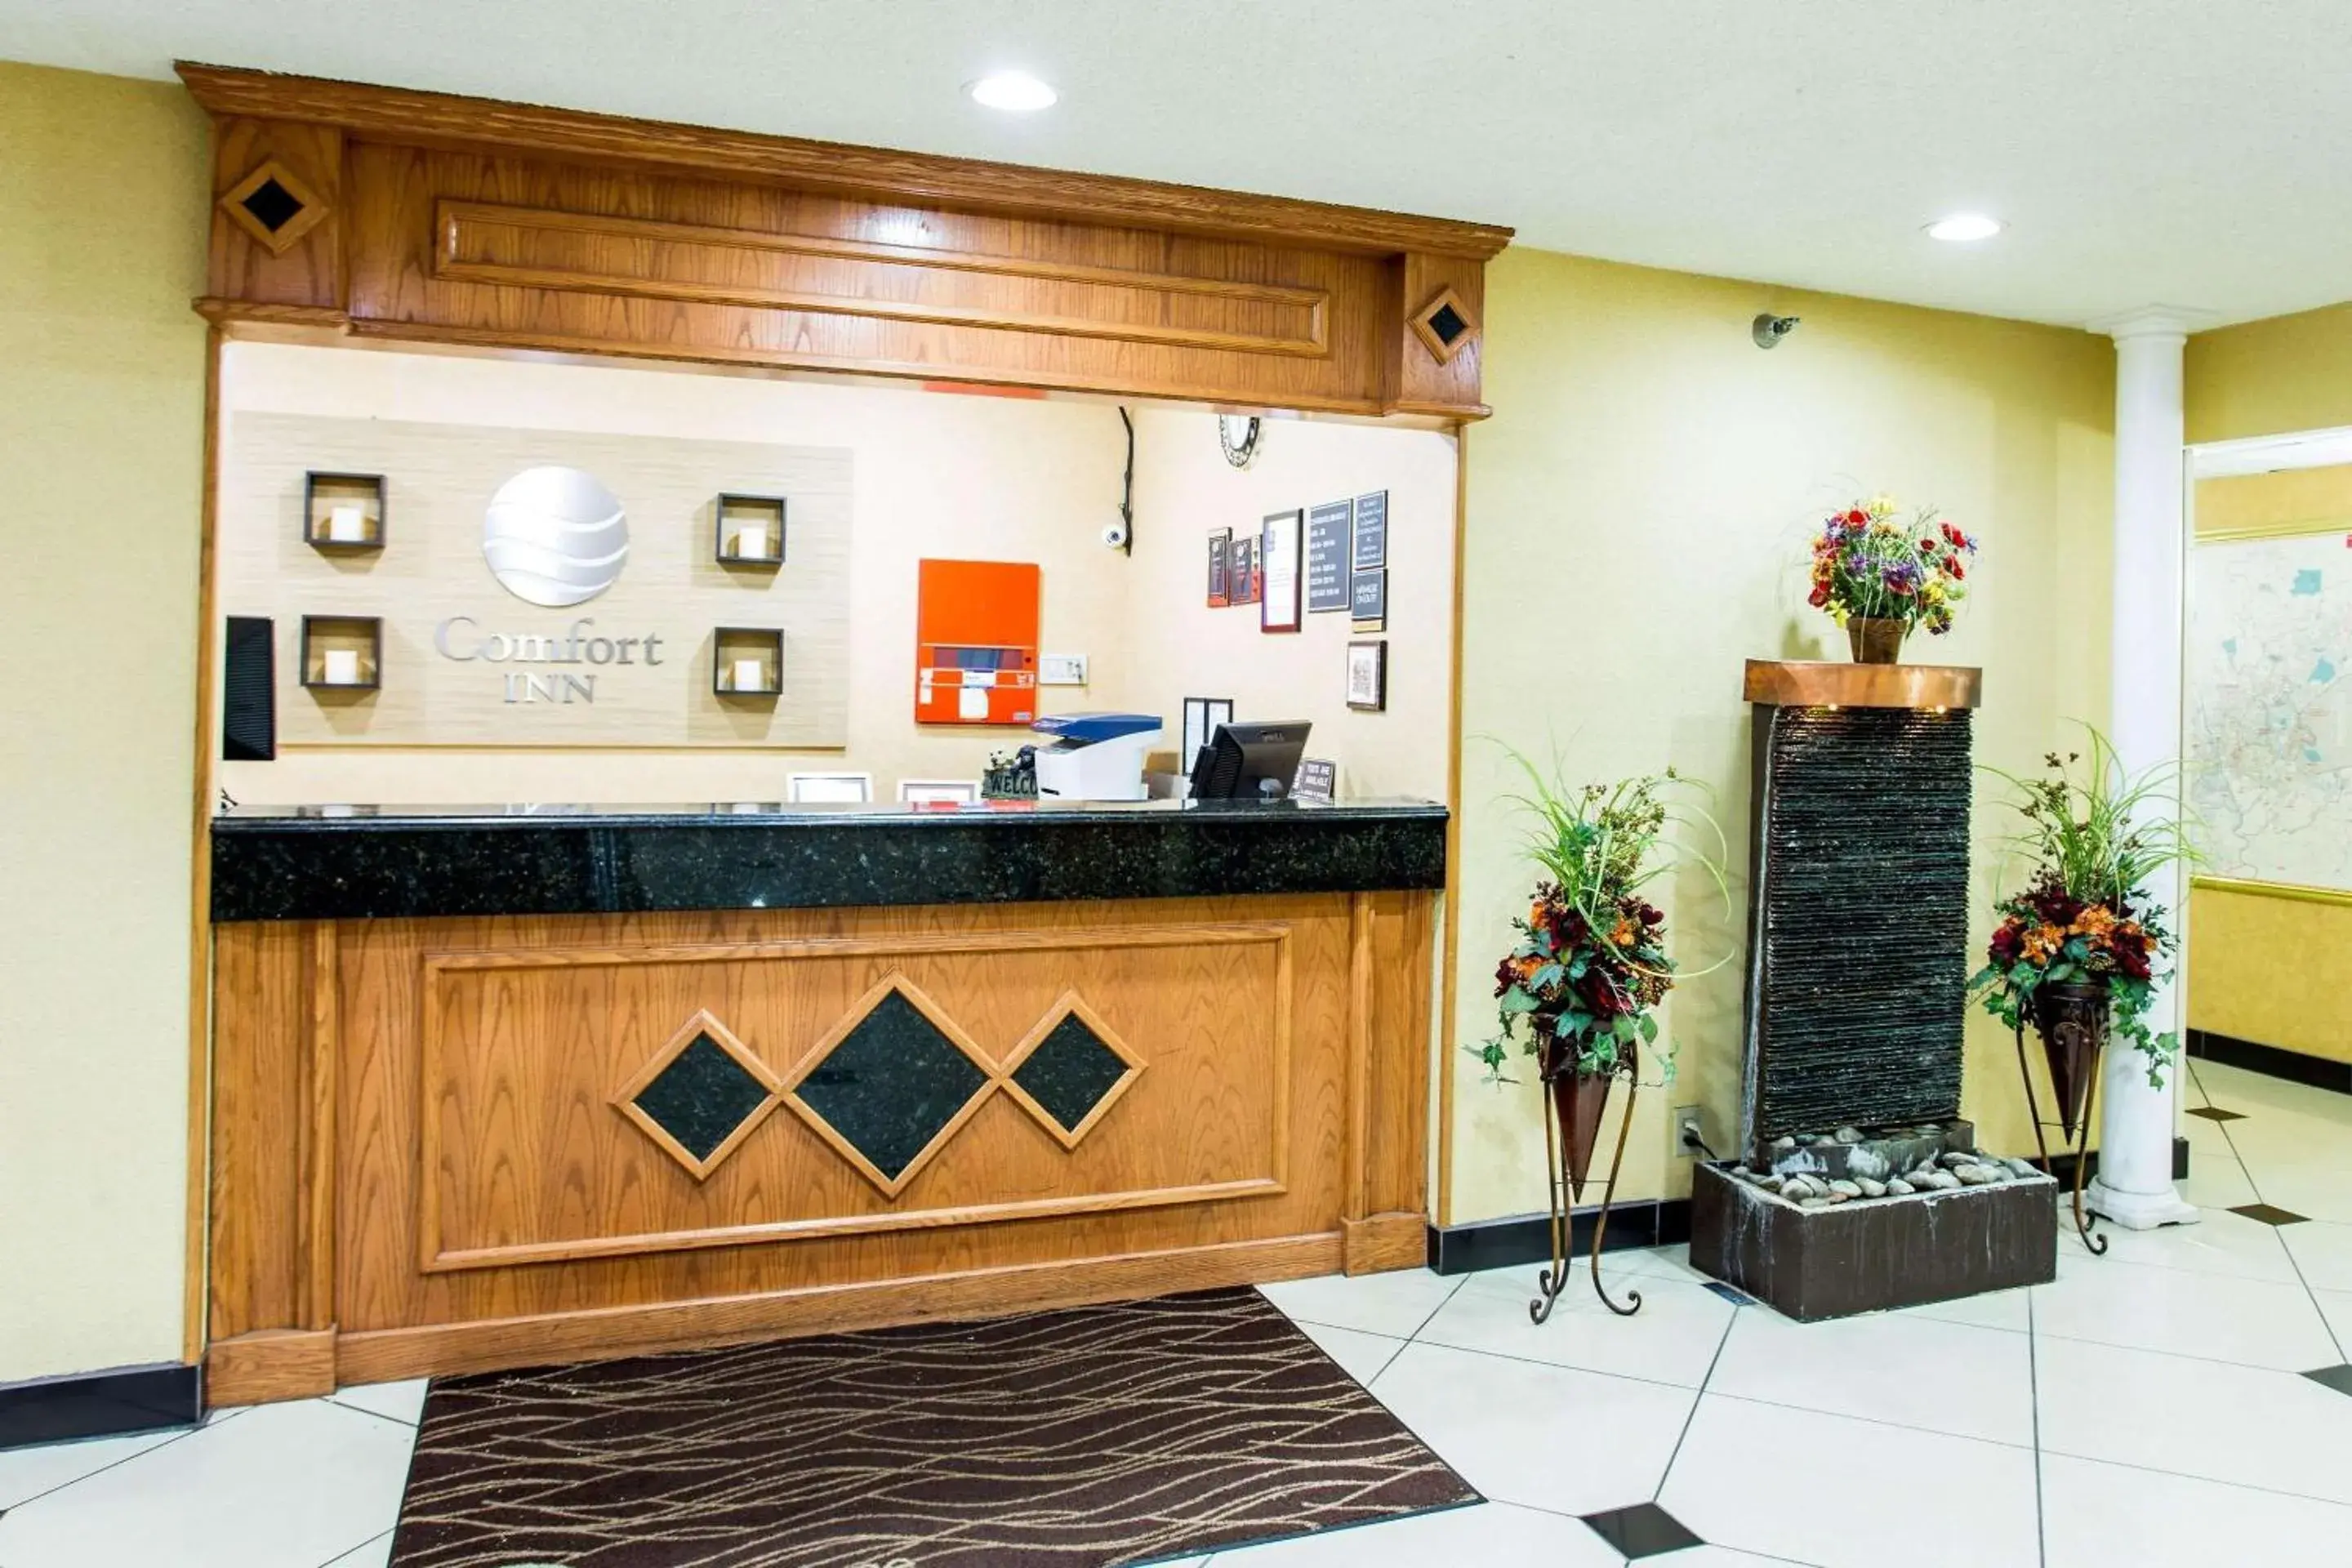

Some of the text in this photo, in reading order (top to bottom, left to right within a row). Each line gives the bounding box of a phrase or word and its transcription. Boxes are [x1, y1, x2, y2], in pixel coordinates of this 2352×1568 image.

[433, 616, 663, 666] Comfort
[503, 670, 597, 704] INN
[990, 773, 1038, 795] WELCO
